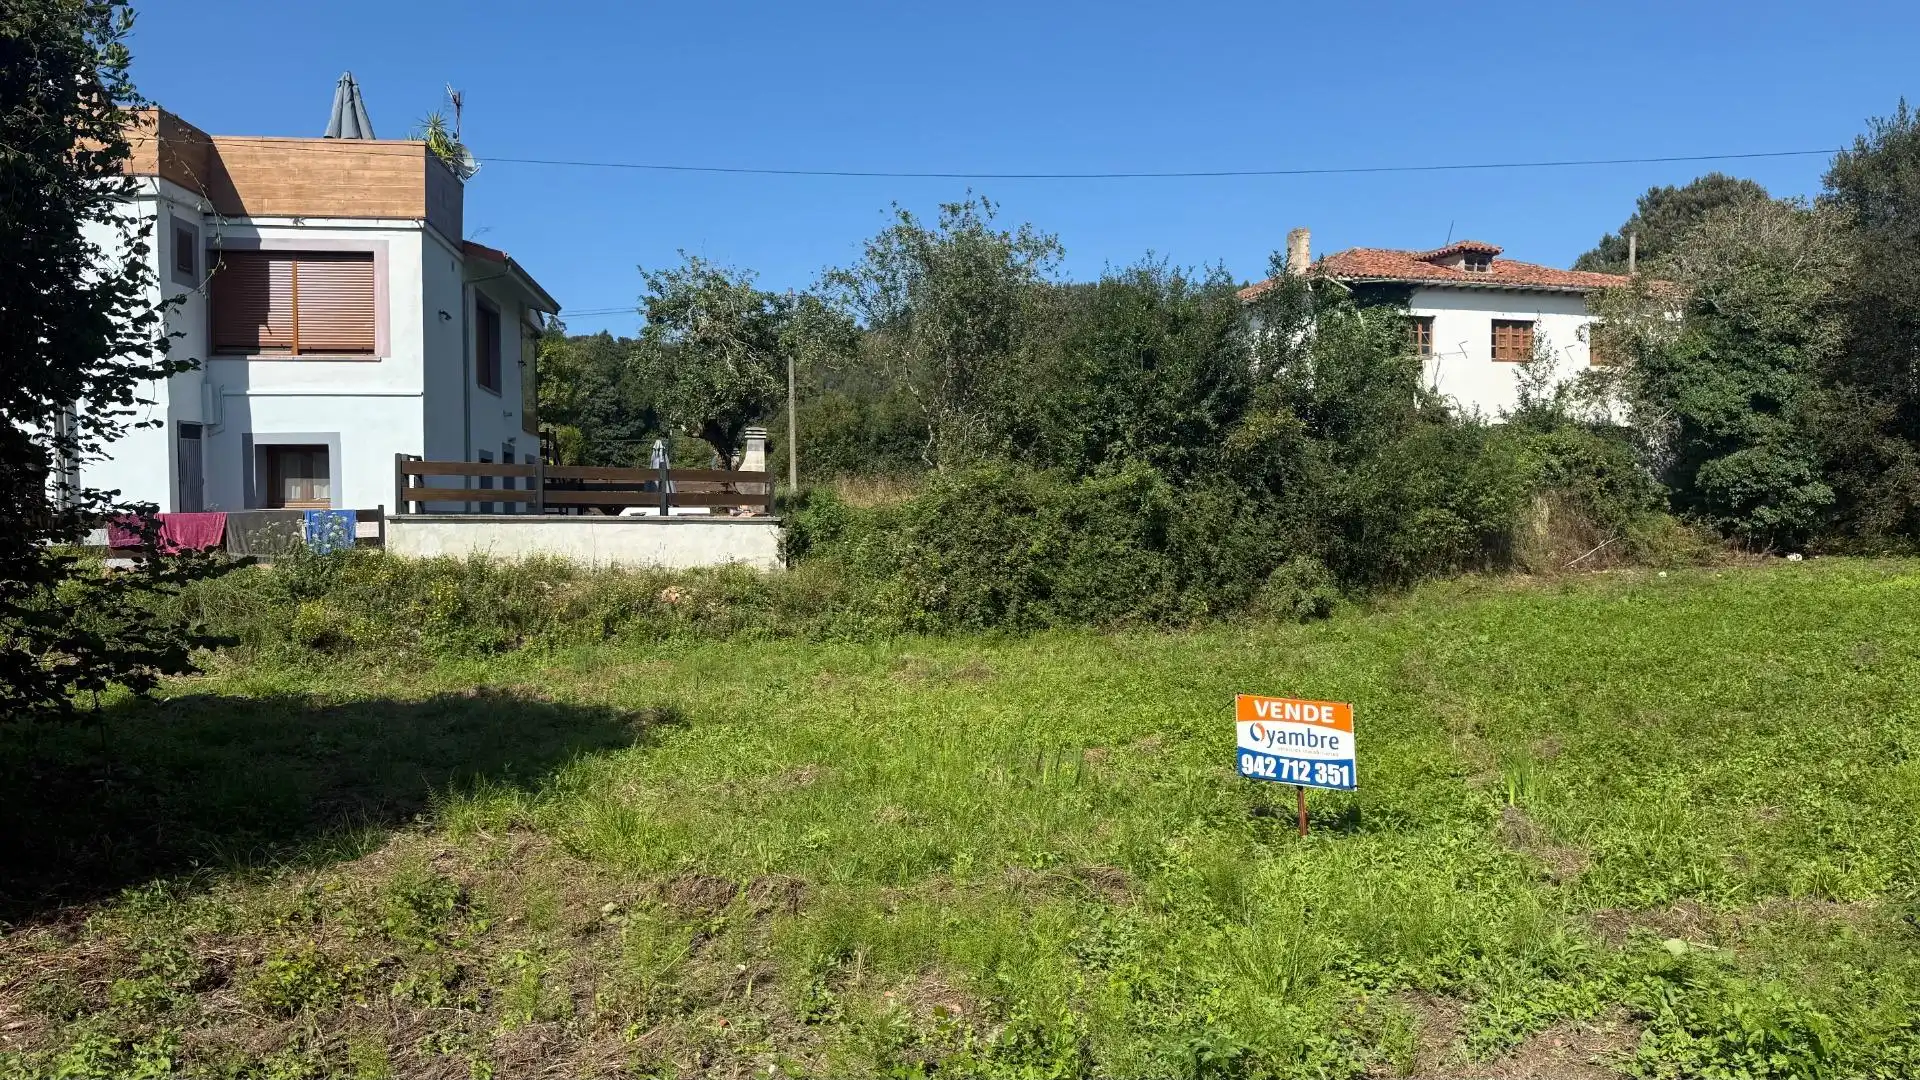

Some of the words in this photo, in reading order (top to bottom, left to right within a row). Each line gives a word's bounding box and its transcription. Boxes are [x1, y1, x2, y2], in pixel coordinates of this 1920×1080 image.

[1253, 700, 1335, 723] VENDE
[1250, 722, 1339, 750] Oyambre
[1241, 754, 1277, 777] 942
[1280, 758, 1311, 782] 712
[1314, 762, 1350, 786] 351
